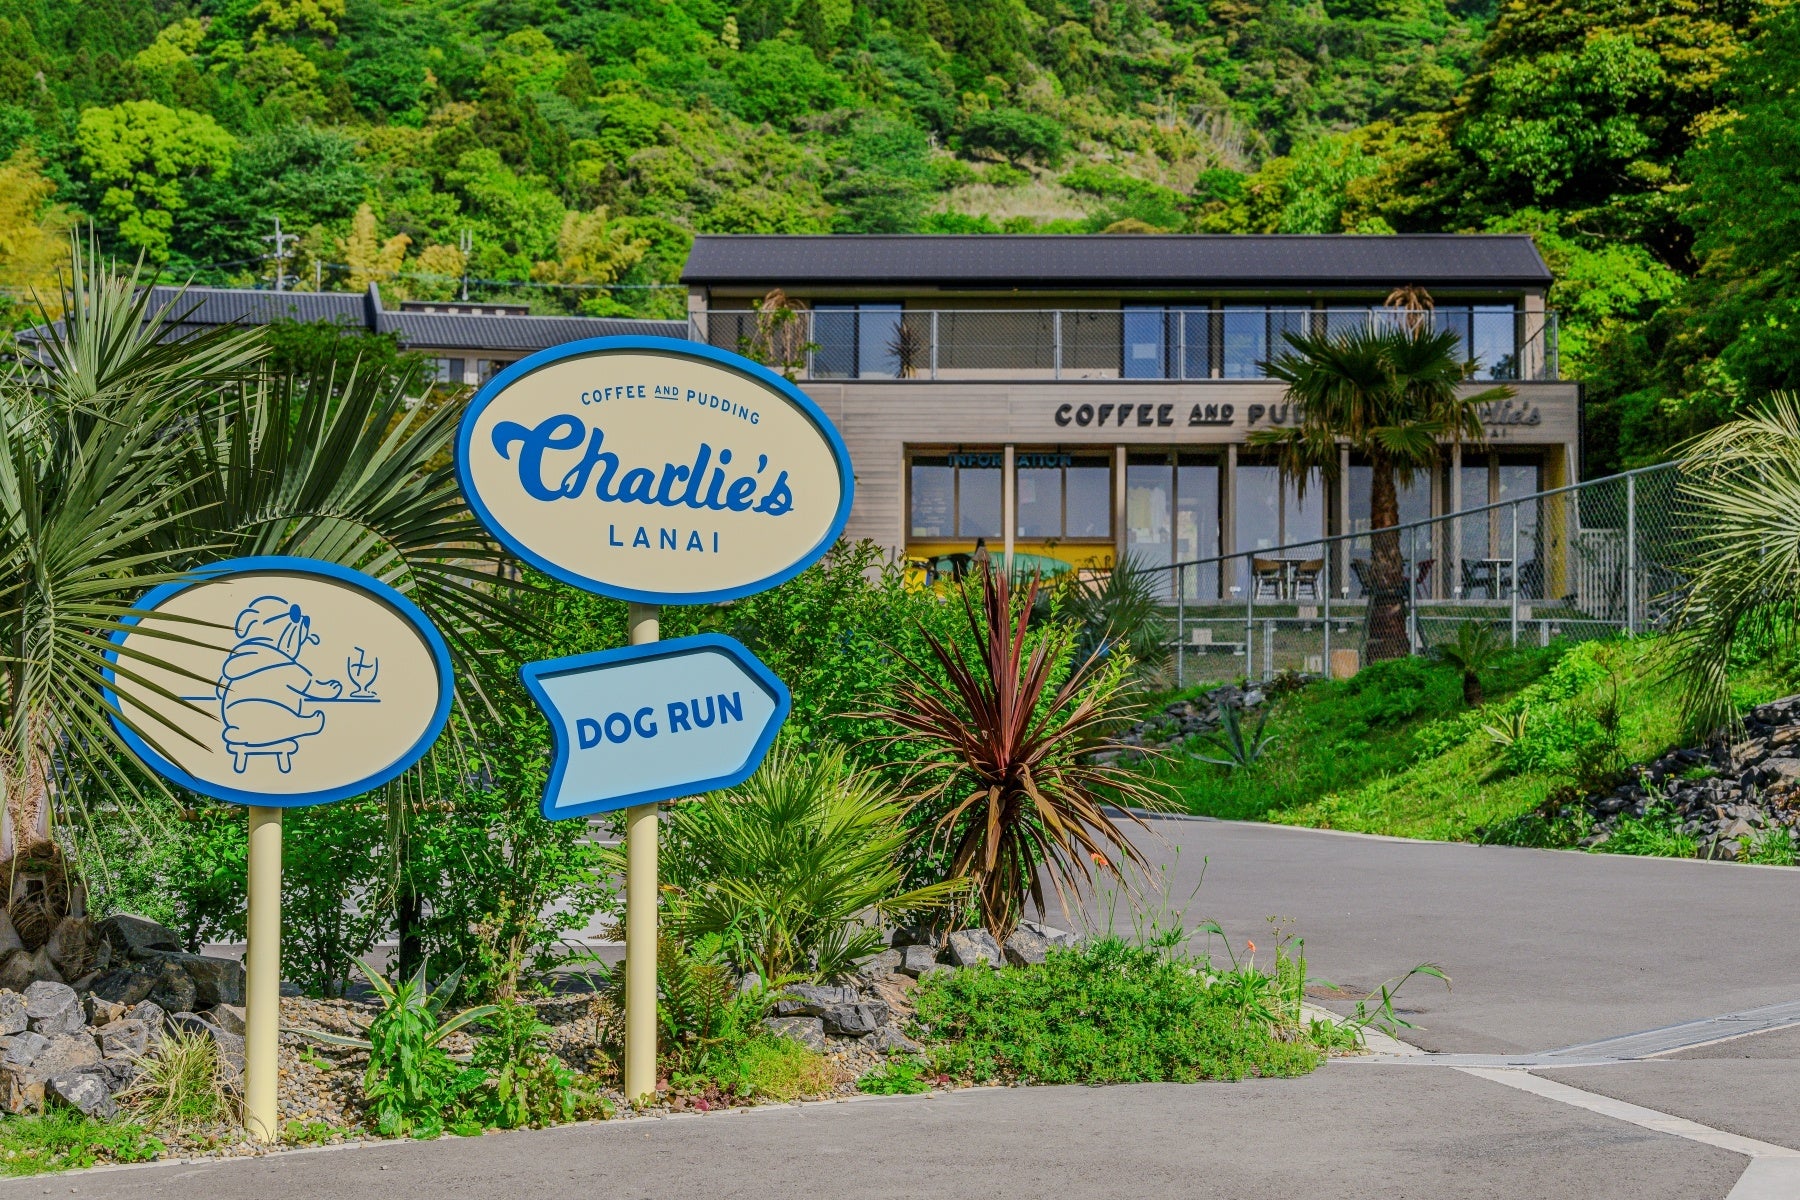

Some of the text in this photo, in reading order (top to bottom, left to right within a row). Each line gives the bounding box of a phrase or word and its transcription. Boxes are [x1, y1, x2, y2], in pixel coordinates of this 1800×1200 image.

[581, 385, 760, 426] COFFEE AND PUDDING
[1054, 403, 1174, 427] COFFEE
[1188, 403, 1235, 427] AND
[491, 413, 794, 517] Charlie's
[947, 453, 1072, 468] INFORATION
[609, 524, 719, 553] LANAI
[576, 691, 743, 750] DOG RUN
